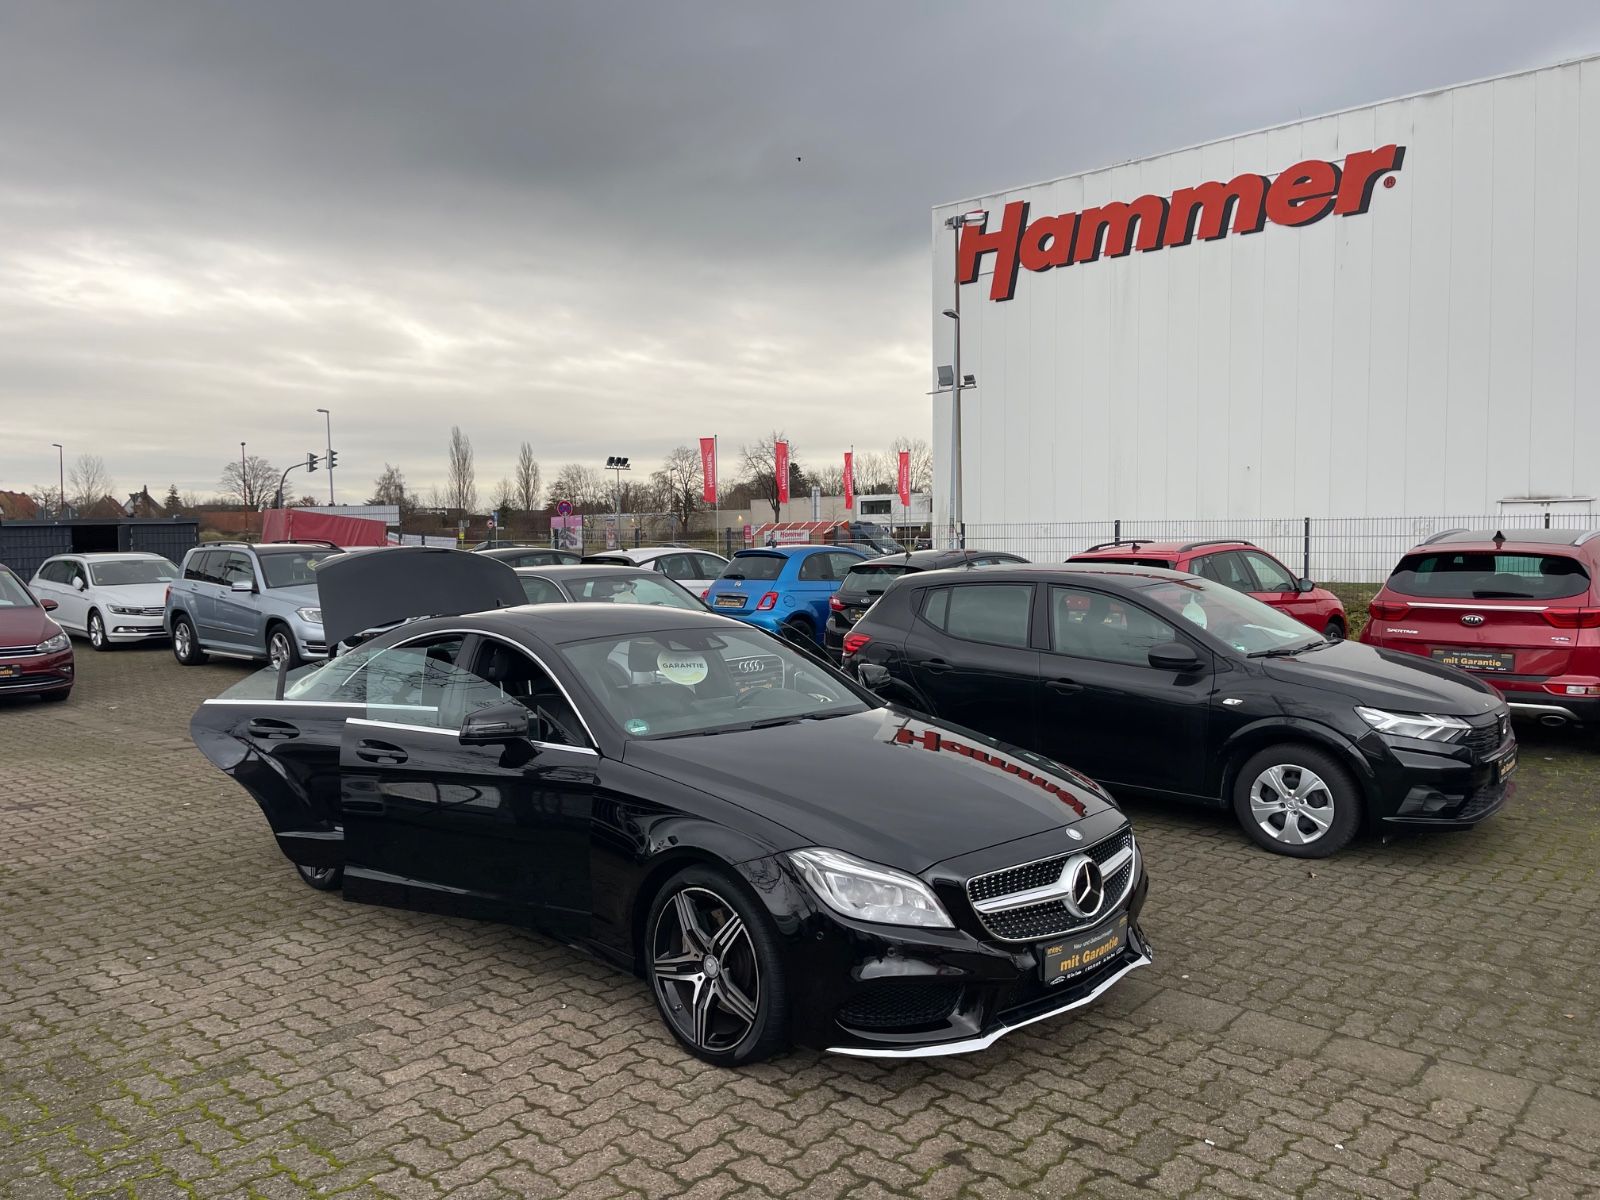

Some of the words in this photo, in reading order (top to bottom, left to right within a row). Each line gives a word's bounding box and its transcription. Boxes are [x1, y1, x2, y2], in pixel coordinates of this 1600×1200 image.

[958, 144, 1400, 301] Hammer
[1461, 657, 1502, 667] Garantie
[1060, 953, 1080, 972] mit
[1083, 935, 1119, 964] Garantie
